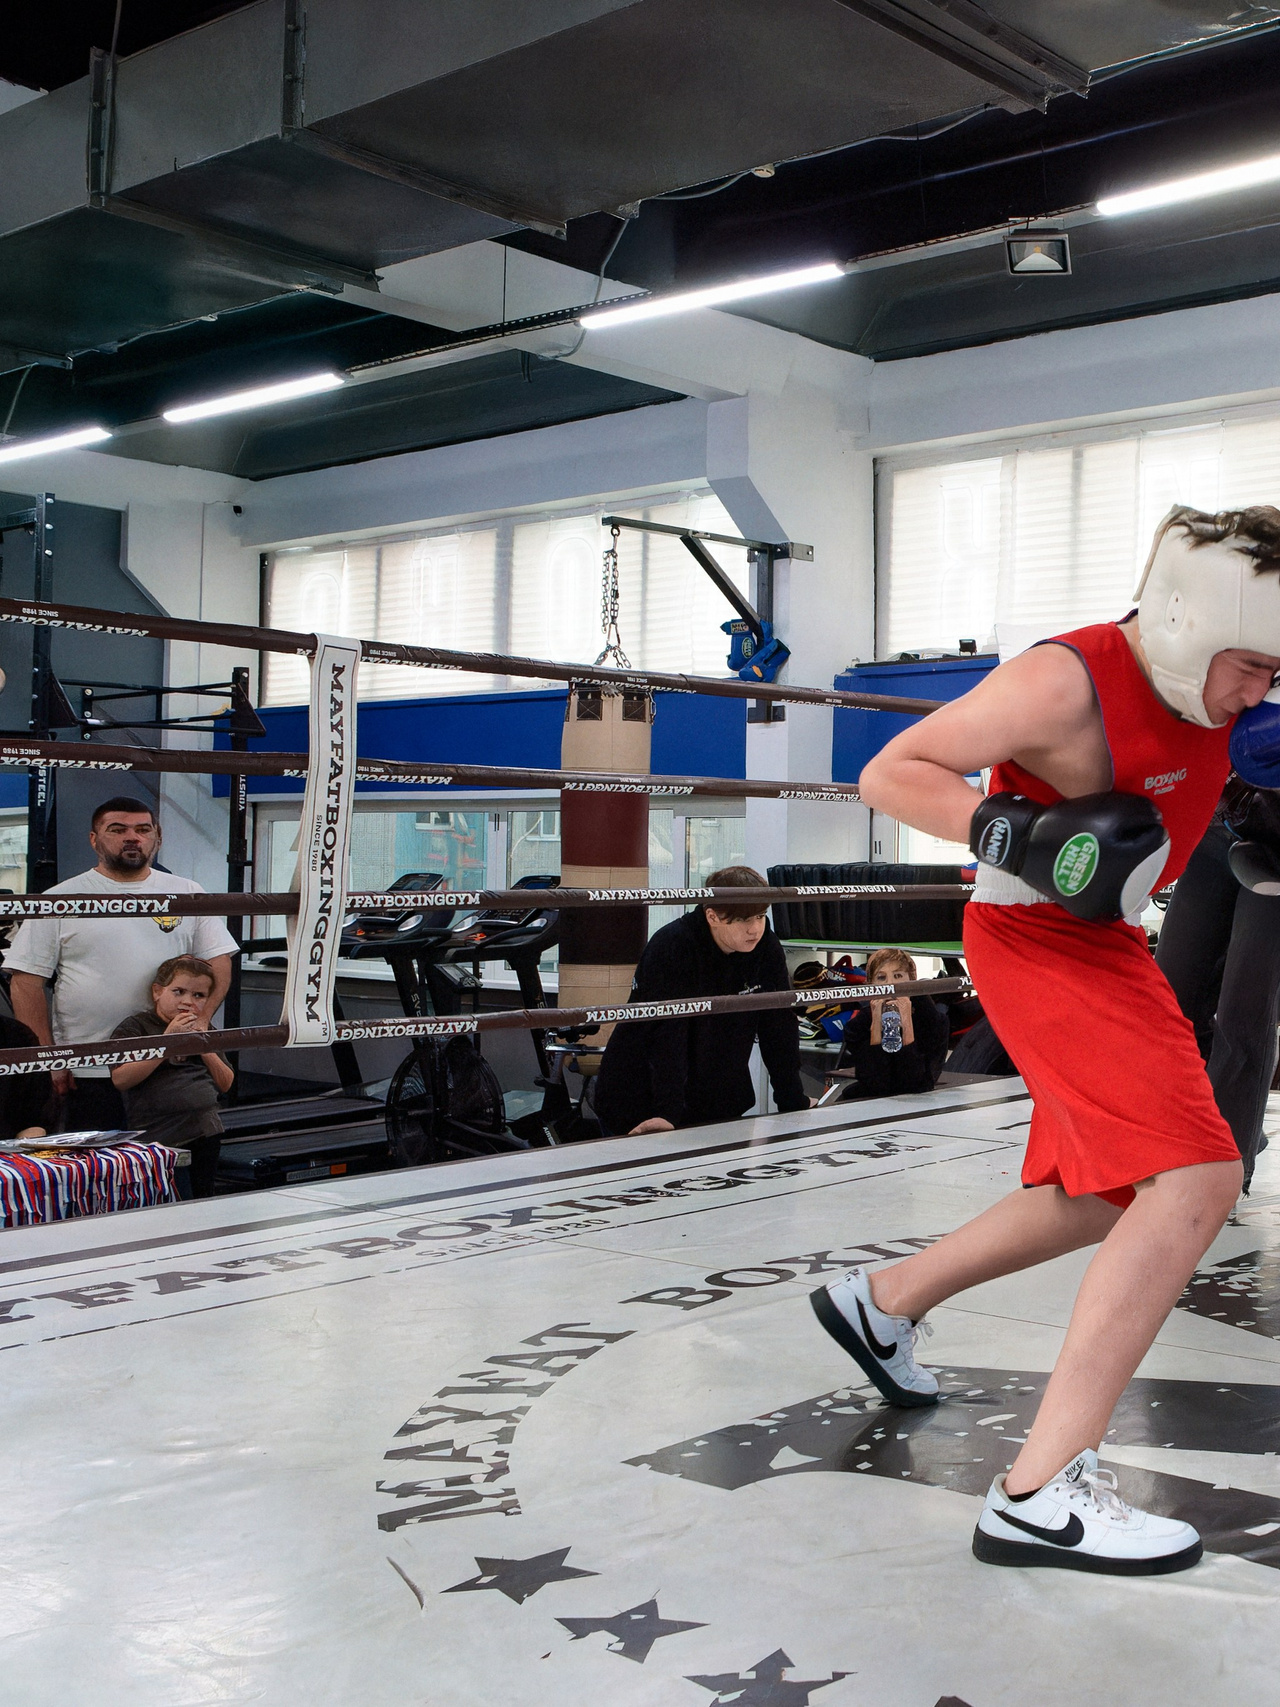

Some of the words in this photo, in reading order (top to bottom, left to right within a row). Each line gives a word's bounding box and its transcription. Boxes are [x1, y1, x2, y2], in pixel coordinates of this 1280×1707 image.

[37, 765, 47, 807] STEEL
[562, 781, 695, 796] MAYFATBOXINGGYM
[305, 662, 346, 1023] MAYFATBOXINGGYM
[313, 814, 323, 847] SINCE
[1058, 844, 1083, 876] HILL
[1067, 841, 1094, 892] GREEN
[587, 887, 715, 901] MAYFATBOXINGGYM
[795, 884, 896, 896] MAYFATBOXINGGYM
[795, 984, 896, 1003] MAYFATBOXINGGYM
[586, 1000, 712, 1023] MAYFATBOXINGGYM
[53, 1049, 74, 1057] SINCE
[415, 1232, 530, 1260] SINCE
[539, 1217, 611, 1240] 1980
[375, 1322, 638, 1532] MAYFAT
[1064, 1460, 1082, 1479] NIKE
